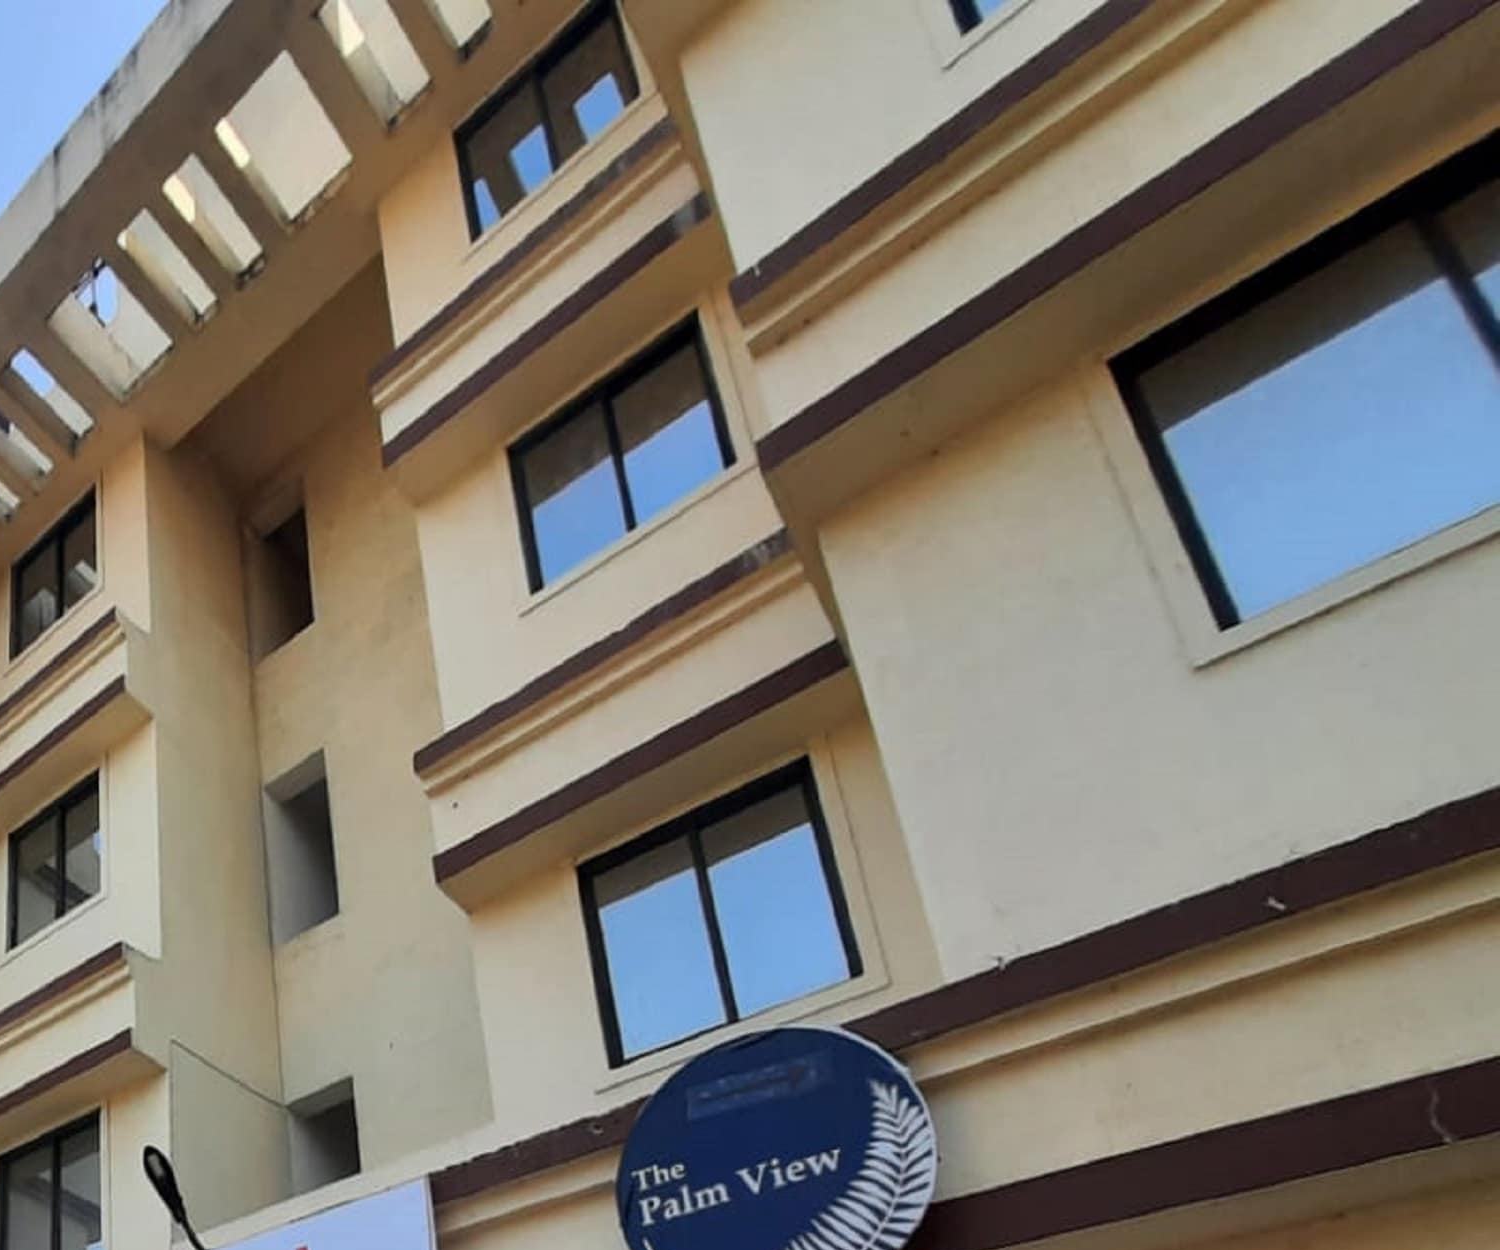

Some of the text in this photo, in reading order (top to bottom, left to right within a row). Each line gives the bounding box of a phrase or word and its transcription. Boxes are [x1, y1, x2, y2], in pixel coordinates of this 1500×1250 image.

[631, 1161, 686, 1193] The
[638, 1147, 842, 1226] Palm View
